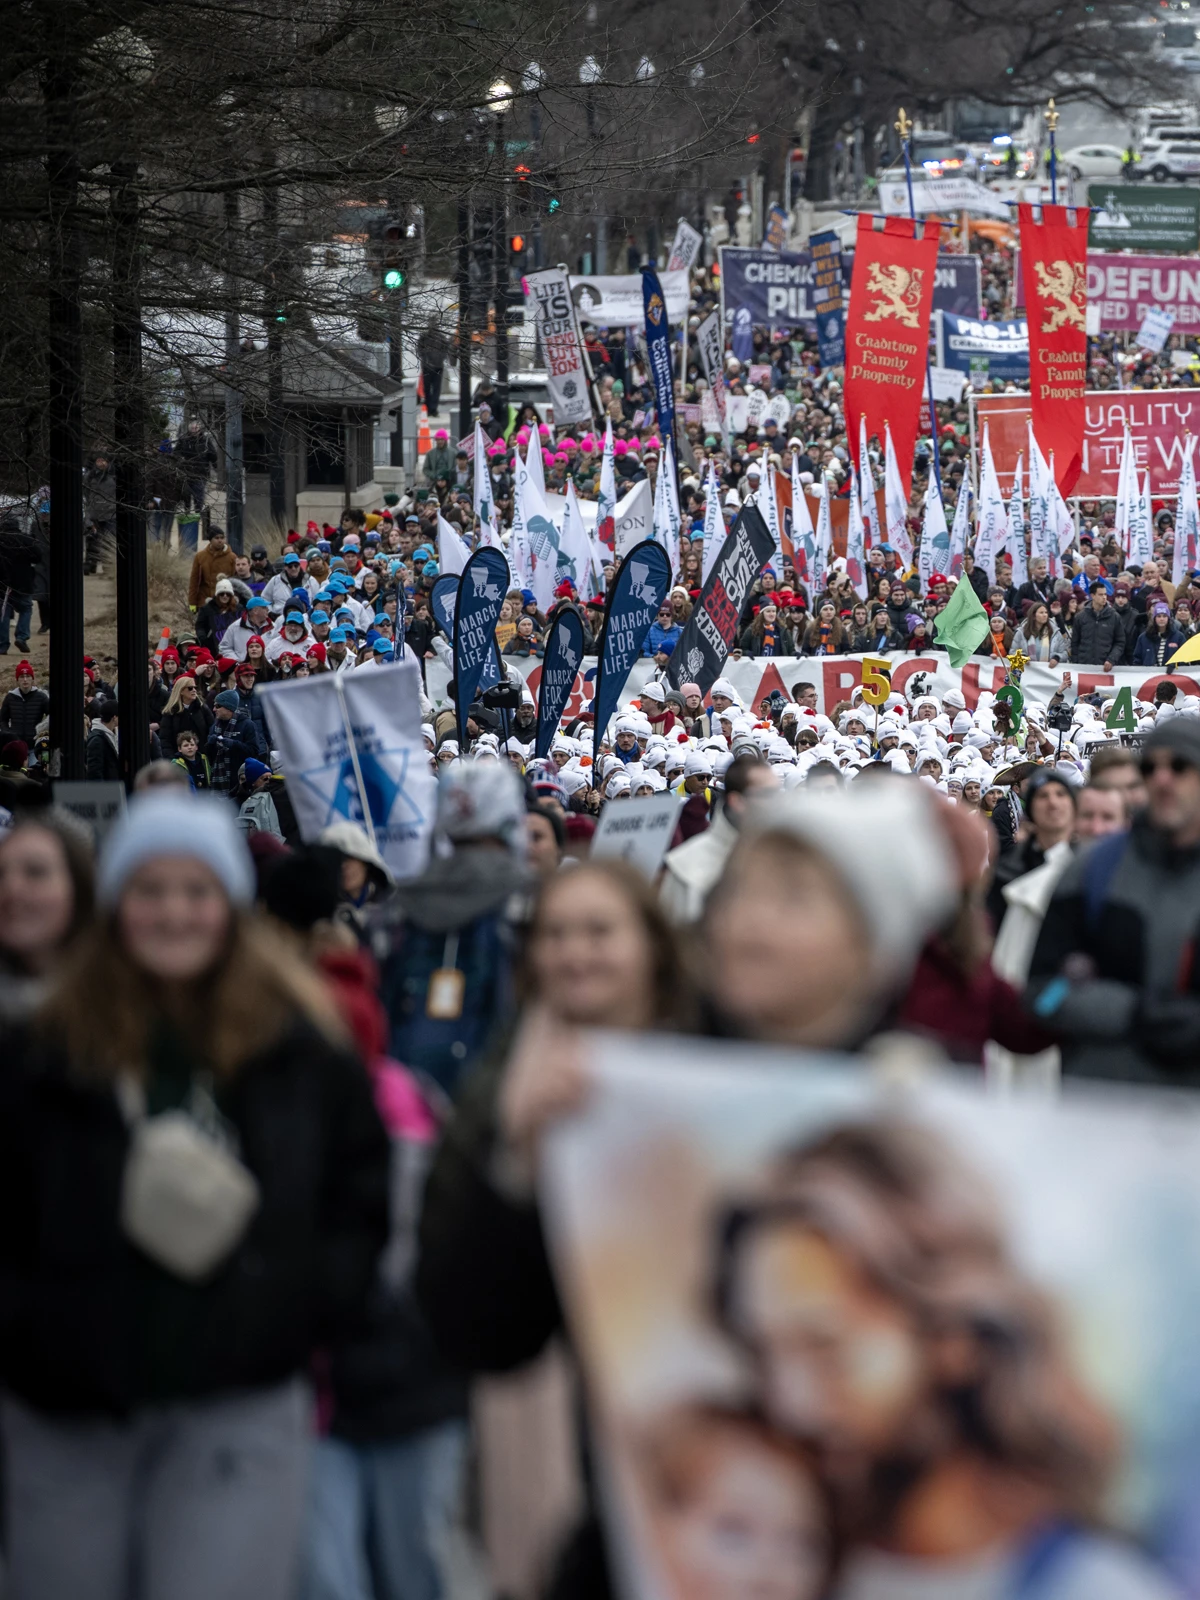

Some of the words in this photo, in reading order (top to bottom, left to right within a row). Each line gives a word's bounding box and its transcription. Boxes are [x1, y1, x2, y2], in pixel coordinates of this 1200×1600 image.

[535, 281, 565, 299] LIFE
[538, 296, 570, 320] IS
[542, 318, 573, 337] OUR
[957, 319, 1028, 340] PRO-LI
[855, 332, 918, 356] Tradition
[862, 349, 909, 372] Family
[851, 364, 916, 390] Property
[1010, 478, 1025, 538] March
[458, 603, 498, 635] MARCH
[609, 608, 651, 634] MARCH
[460, 626, 487, 653] FOR
[608, 631, 635, 656] FOR
[694, 606, 728, 663] HERE!
[458, 649, 483, 671] LIFE
[604, 653, 631, 676] LIFE
[546, 669, 573, 686] MARCH
[861, 657, 892, 706] 5
[544, 685, 562, 706] FOR
[542, 705, 560, 722] LIFE
[1106, 686, 1139, 733] 4
